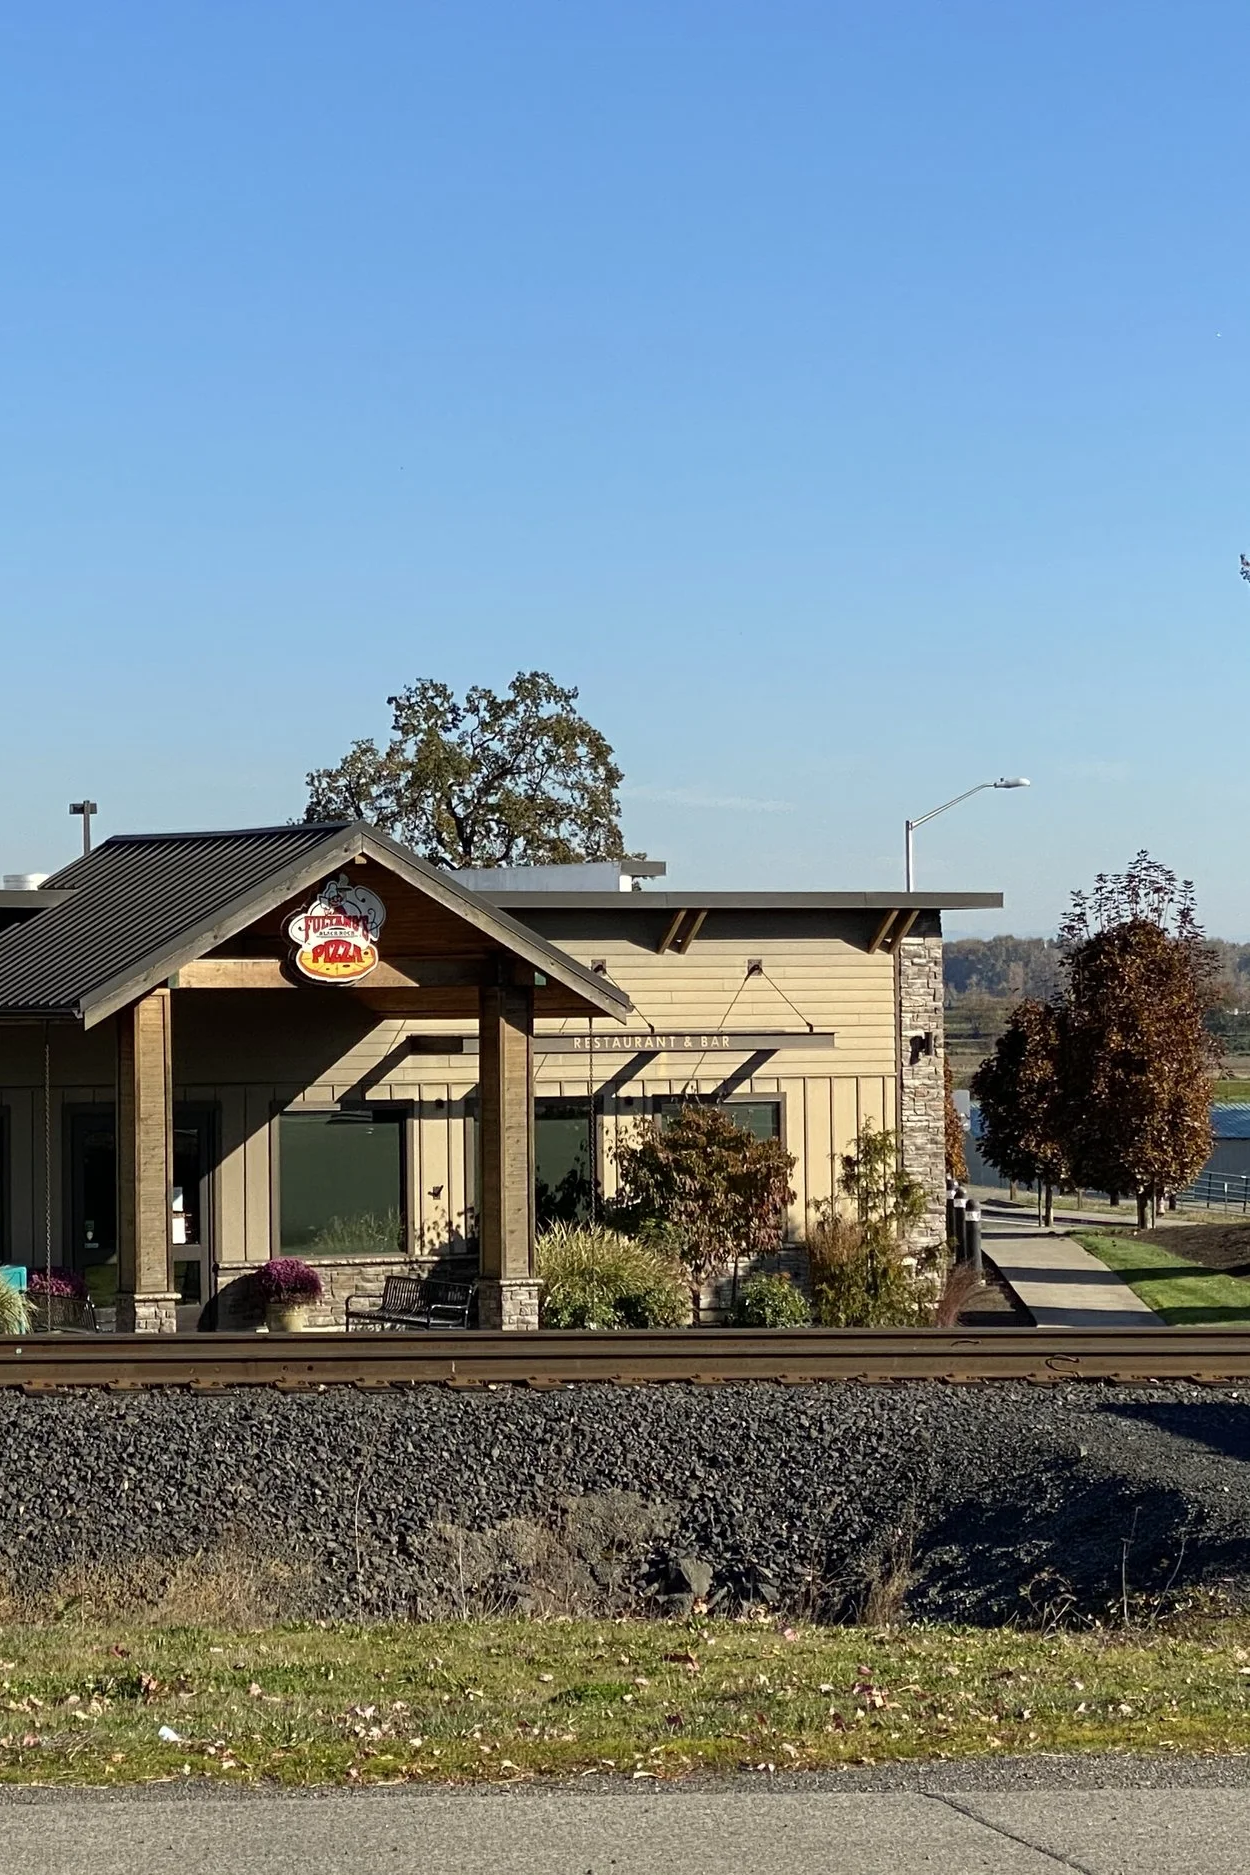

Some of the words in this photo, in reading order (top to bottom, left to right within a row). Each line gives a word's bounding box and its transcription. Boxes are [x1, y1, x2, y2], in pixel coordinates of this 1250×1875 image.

[304, 915, 370, 944] FULTANO'S
[312, 939, 365, 964] PIZZA
[573, 1036, 676, 1049] RESTAURANT
[683, 1035, 693, 1048] &
[700, 1035, 730, 1048] BAR
